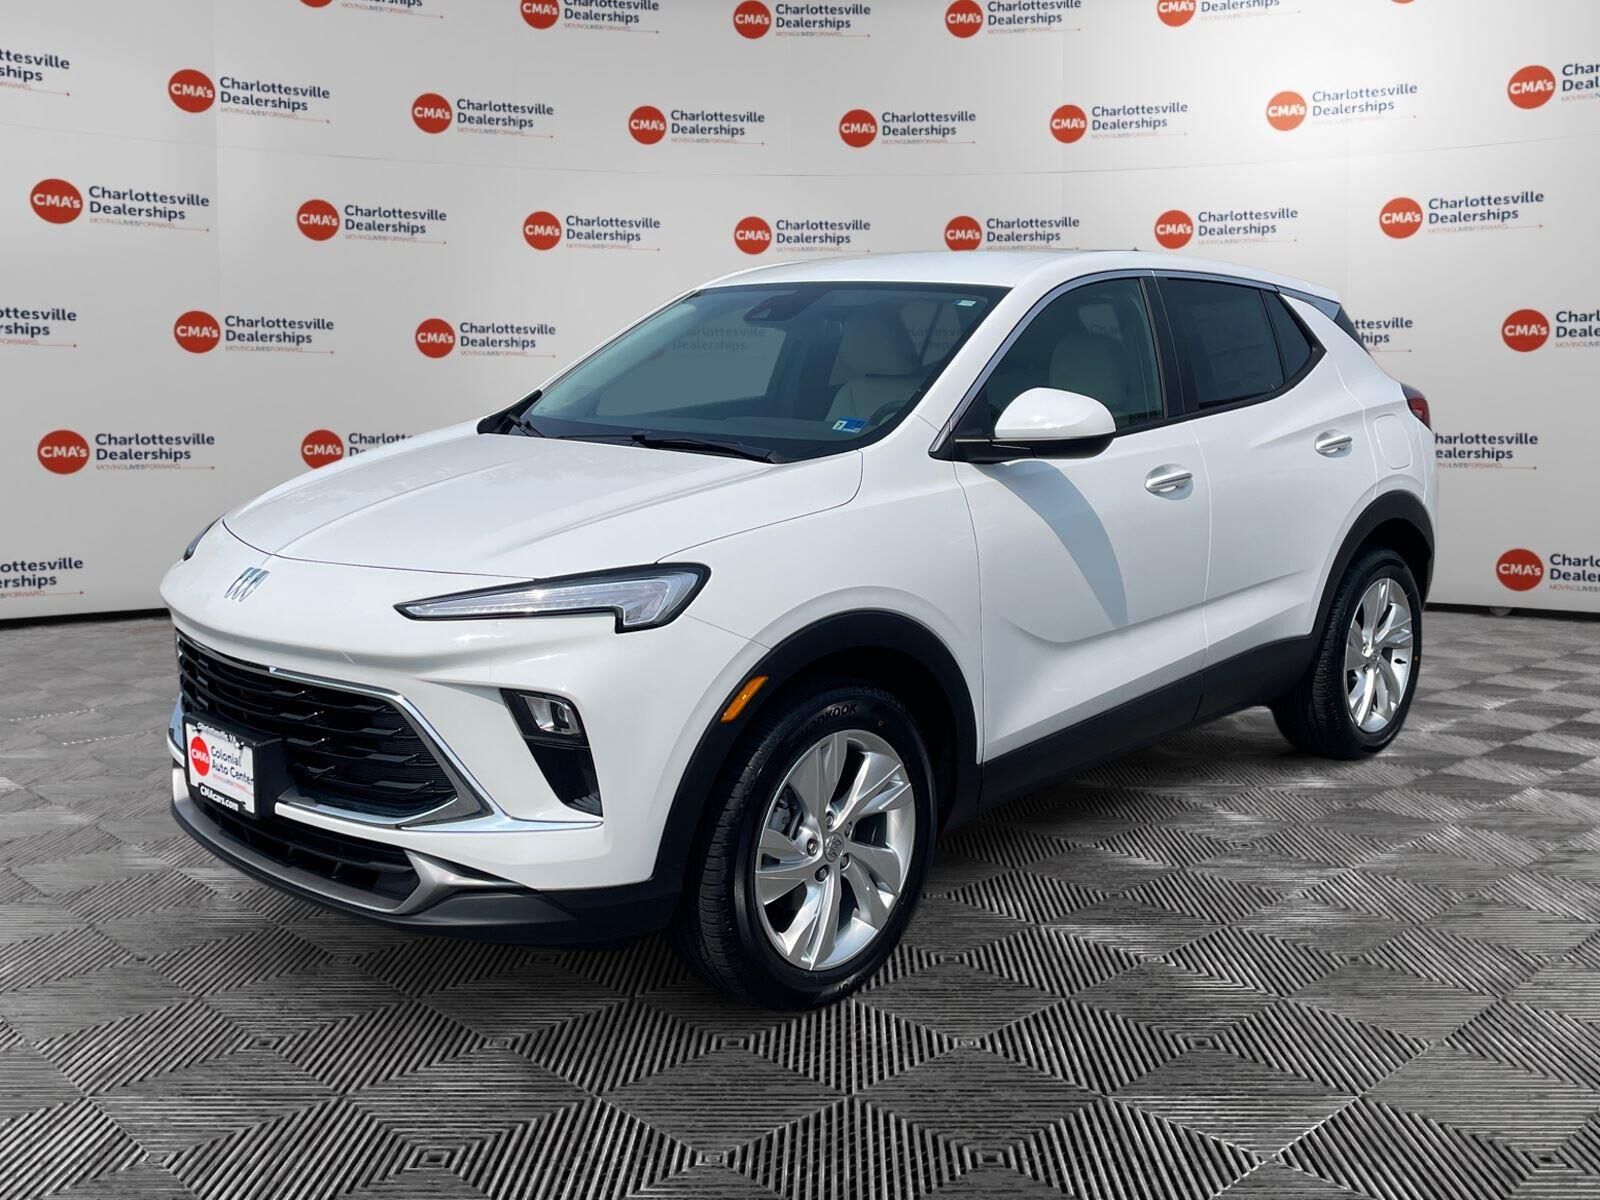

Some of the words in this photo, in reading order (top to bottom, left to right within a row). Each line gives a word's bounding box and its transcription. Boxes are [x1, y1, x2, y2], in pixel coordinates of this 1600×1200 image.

[523, 2, 557, 15] CMA's
[564, 0, 659, 11] Charlottesville
[775, 3, 871, 15] Charlottesville
[987, 0, 1081, 13] Charlottesville
[1158, 0, 1194, 12] CMA's
[1202, 0, 1279, 12] Dealerships
[564, 8, 640, 25] Dealerships
[735, 13, 769, 25] CMA's
[776, 16, 850, 31] Dealerships
[947, 13, 981, 24] CMA's
[987, 13, 1062, 26] Dealerships
[0, 49, 70, 70] ttesville
[171, 83, 213, 98] CMA's
[219, 77, 330, 99] Charlottesville
[1312, 83, 1418, 102] Charlottesville
[1510, 79, 1554, 96] CMA's
[220, 91, 308, 112] Dealerships
[457, 98, 554, 116] Charlottesville
[1312, 99, 1395, 117] Dealerships
[414, 107, 450, 120] CMA's
[671, 109, 765, 123] Charlottesville
[881, 110, 977, 123] Charlottesville
[1091, 102, 1188, 117] Charlottesville
[1268, 103, 1305, 117] CMA's
[457, 112, 534, 130] Dealerships
[630, 119, 666, 131] CMA's
[841, 122, 876, 133] CMA's
[1052, 117, 1087, 129] CMA's
[1091, 117, 1167, 131] Dealerships
[671, 123, 746, 138] Dealerships
[881, 124, 957, 139] Dealerships
[33, 192, 81, 208] CMA's
[88, 186, 210, 207] Charlottesville
[1428, 190, 1545, 210] Charlottesville
[89, 201, 186, 222] Dealerships
[343, 205, 447, 222] Charlottesville
[1198, 207, 1298, 223] Charlottesville
[1380, 211, 1421, 226] CMA's
[1428, 207, 1519, 225] Dealerships
[299, 213, 338, 227] CMA's
[566, 215, 661, 228] Charlottesville
[776, 219, 870, 230] Charlottesville
[986, 217, 1080, 230] Charlottesville
[344, 219, 427, 237] Dealerships
[525, 225, 561, 237] CMA's
[736, 229, 770, 240] CMA's
[947, 229, 981, 240] CMA's
[1157, 223, 1193, 236] CMA's
[1198, 222, 1277, 237] Dealerships
[566, 228, 642, 244] Dealerships
[776, 232, 851, 247] Dealerships
[986, 230, 1061, 243] Dealerships
[0, 306, 77, 322] ttesville
[225, 315, 335, 331] Charlottesville
[459, 321, 557, 335] Charlottesville
[1355, 317, 1414, 329] ttesville
[176, 325, 219, 339] CMA's
[225, 329, 313, 347] Dealerships
[417, 332, 453, 344] CMA's
[1504, 325, 1547, 337] CMA's
[460, 335, 537, 351] Dealerships
[95, 432, 215, 446] Charlottesville
[1435, 432, 1539, 445] harlottesville
[40, 445, 89, 459] CMA's
[95, 447, 192, 464] Dealerships
[304, 444, 342, 456] CMA's
[1435, 446, 1513, 462] ealerships
[0, 557, 84, 573] ottesville
[1499, 563, 1542, 577] CMA's
[211, 745, 242, 767] Colonial
[212, 759, 229, 775] Auto
[230, 767, 255, 785] Center
